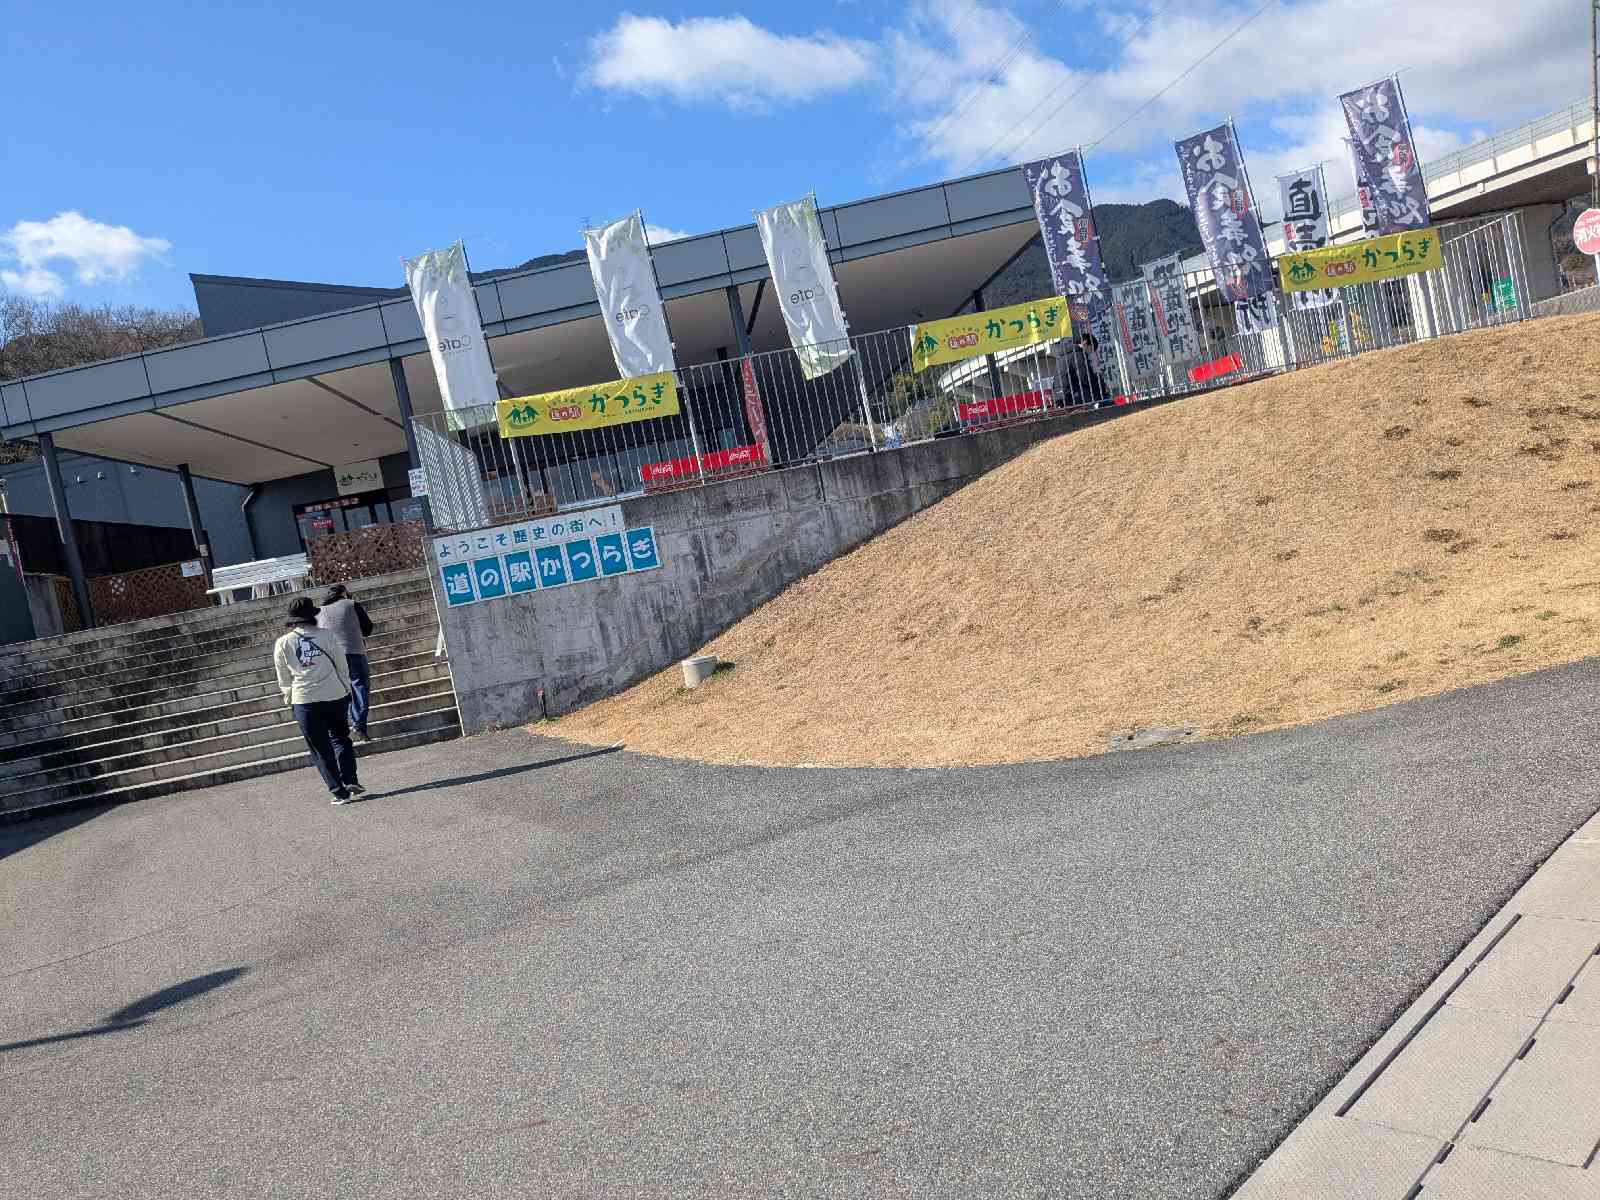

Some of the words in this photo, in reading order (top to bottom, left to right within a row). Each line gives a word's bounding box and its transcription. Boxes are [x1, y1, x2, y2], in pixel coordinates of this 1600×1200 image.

[1363, 237, 1432, 268] かつらぎ
[985, 306, 1058, 338] かつらぎ
[589, 383, 665, 413] かつらぎ
[439, 512, 616, 558] ようこそ歴史の街へ！
[448, 536, 651, 594] 道の駅かつらぎ
